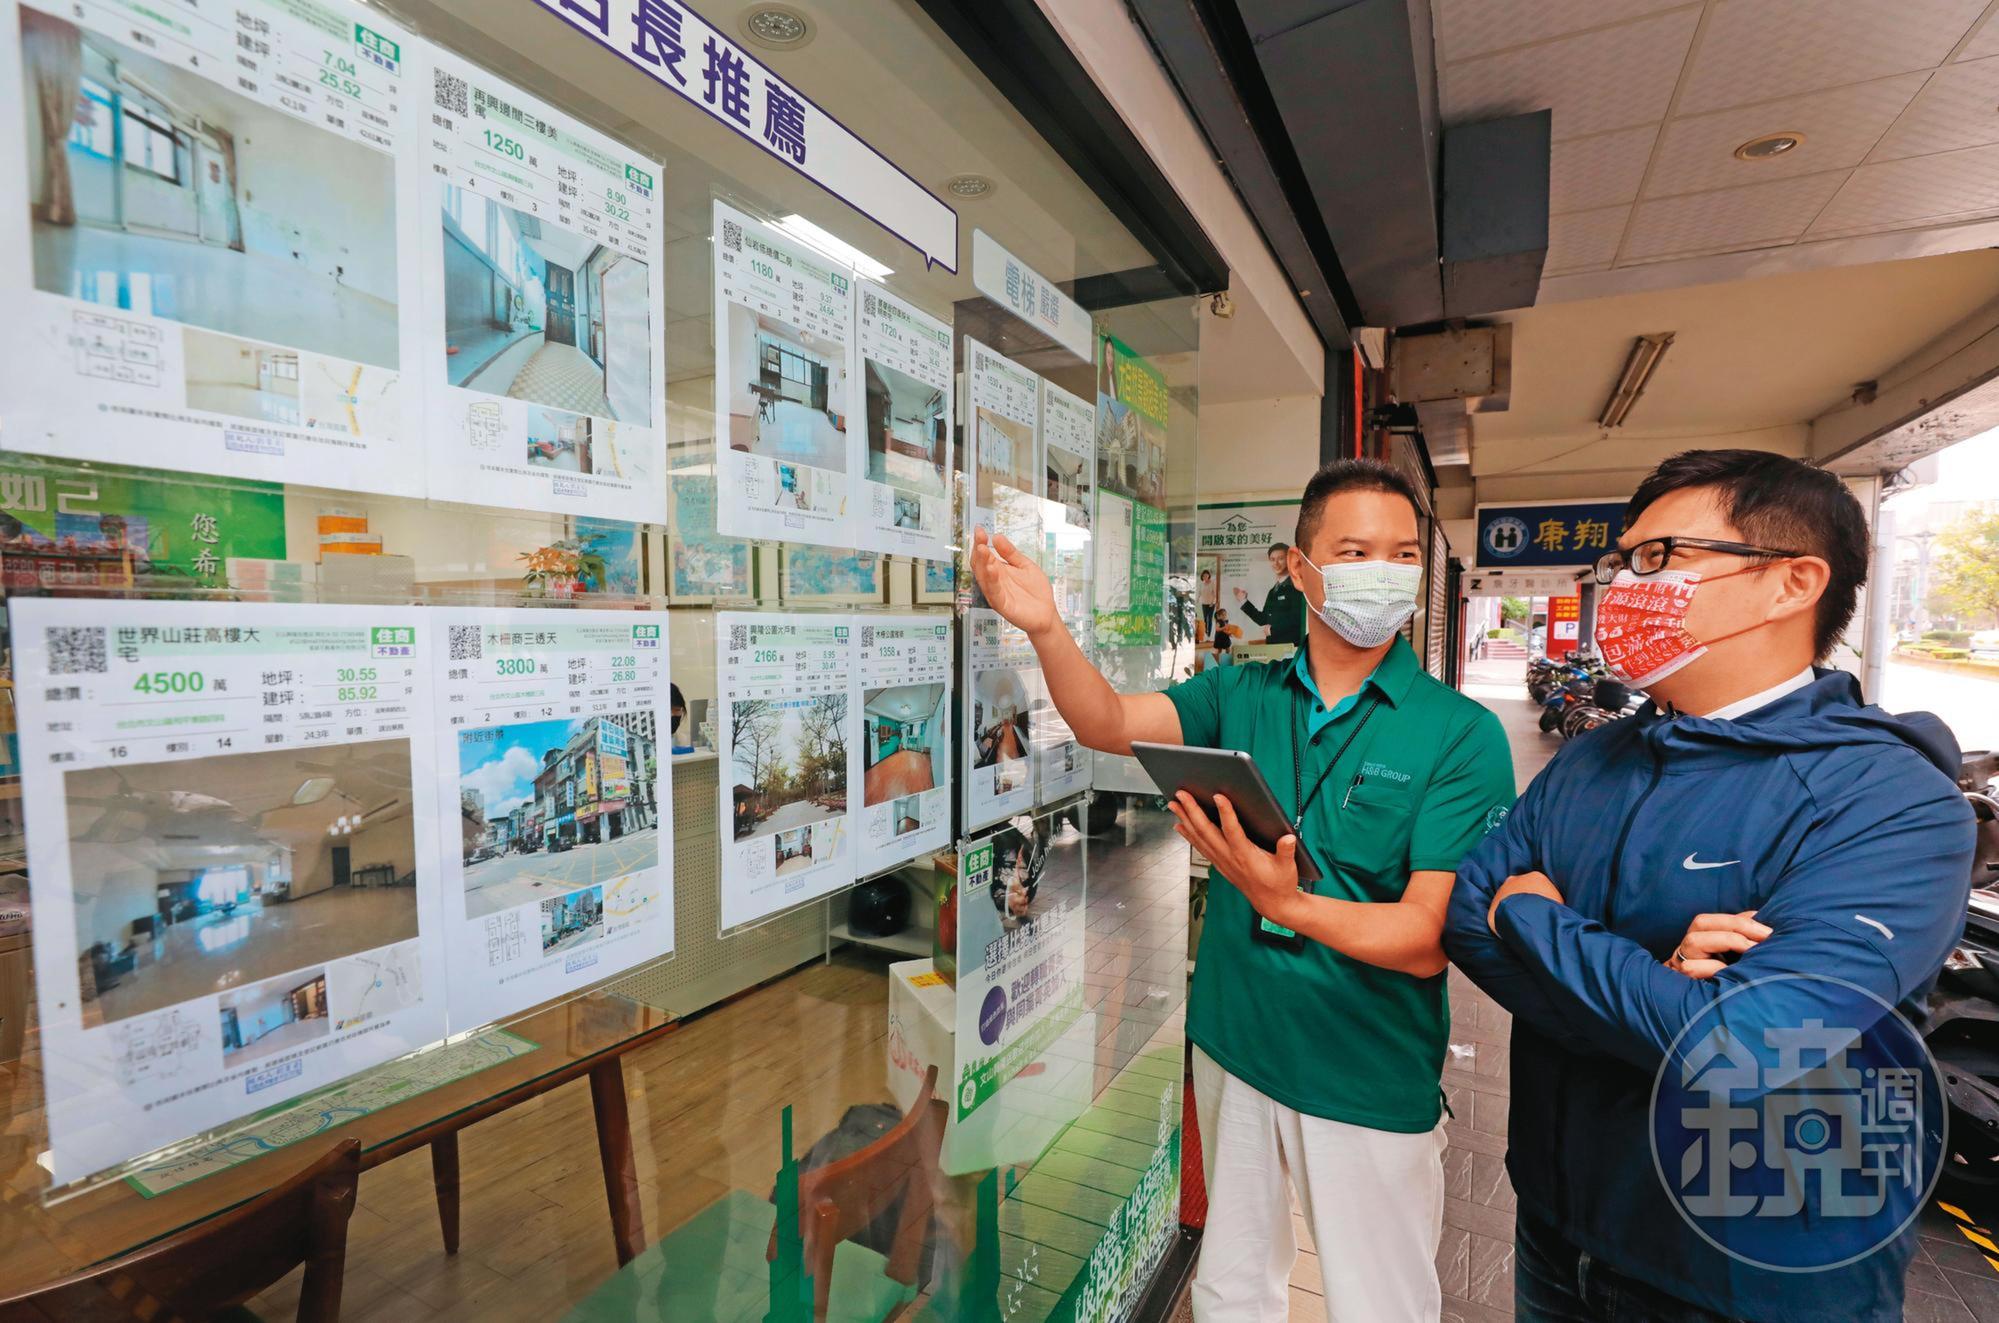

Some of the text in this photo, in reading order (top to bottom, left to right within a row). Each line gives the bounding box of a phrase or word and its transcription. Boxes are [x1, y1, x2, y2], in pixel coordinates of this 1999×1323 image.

[323, 50, 357, 77] 7.04
[319, 69, 362, 99] 25.52
[559, 0, 806, 166] 長推薦
[483, 129, 525, 162] 1250
[606, 188, 627, 206] 8.90
[532, 202, 538, 213] 3
[604, 202, 630, 222] 30.22
[750, 259, 773, 280] 1180
[881, 322, 897, 339] 1720
[1227, 522, 1247, 532] 為您
[1533, 518, 1623, 552] 康翔
[1202, 533, 1272, 546] 開啟家的美好
[117, 627, 260, 644] 世界山莊高樓大
[487, 632, 557, 646] 木柵商三透天
[117, 646, 139, 662] 宅
[754, 650, 777, 662] 2166
[879, 646, 896, 656] 1358
[337, 668, 377, 682] 30.55
[496, 658, 536, 676] 3800
[133, 671, 204, 694] 4500
[612, 670, 636, 682] 26.80
[338, 686, 377, 701] 85.92
[217, 737, 232, 748] 14
[463, 729, 504, 744] 附近街景
[1381, 769, 1410, 782] GROUP
[968, 849, 990, 873] 住商
[969, 870, 989, 887] 不動產
